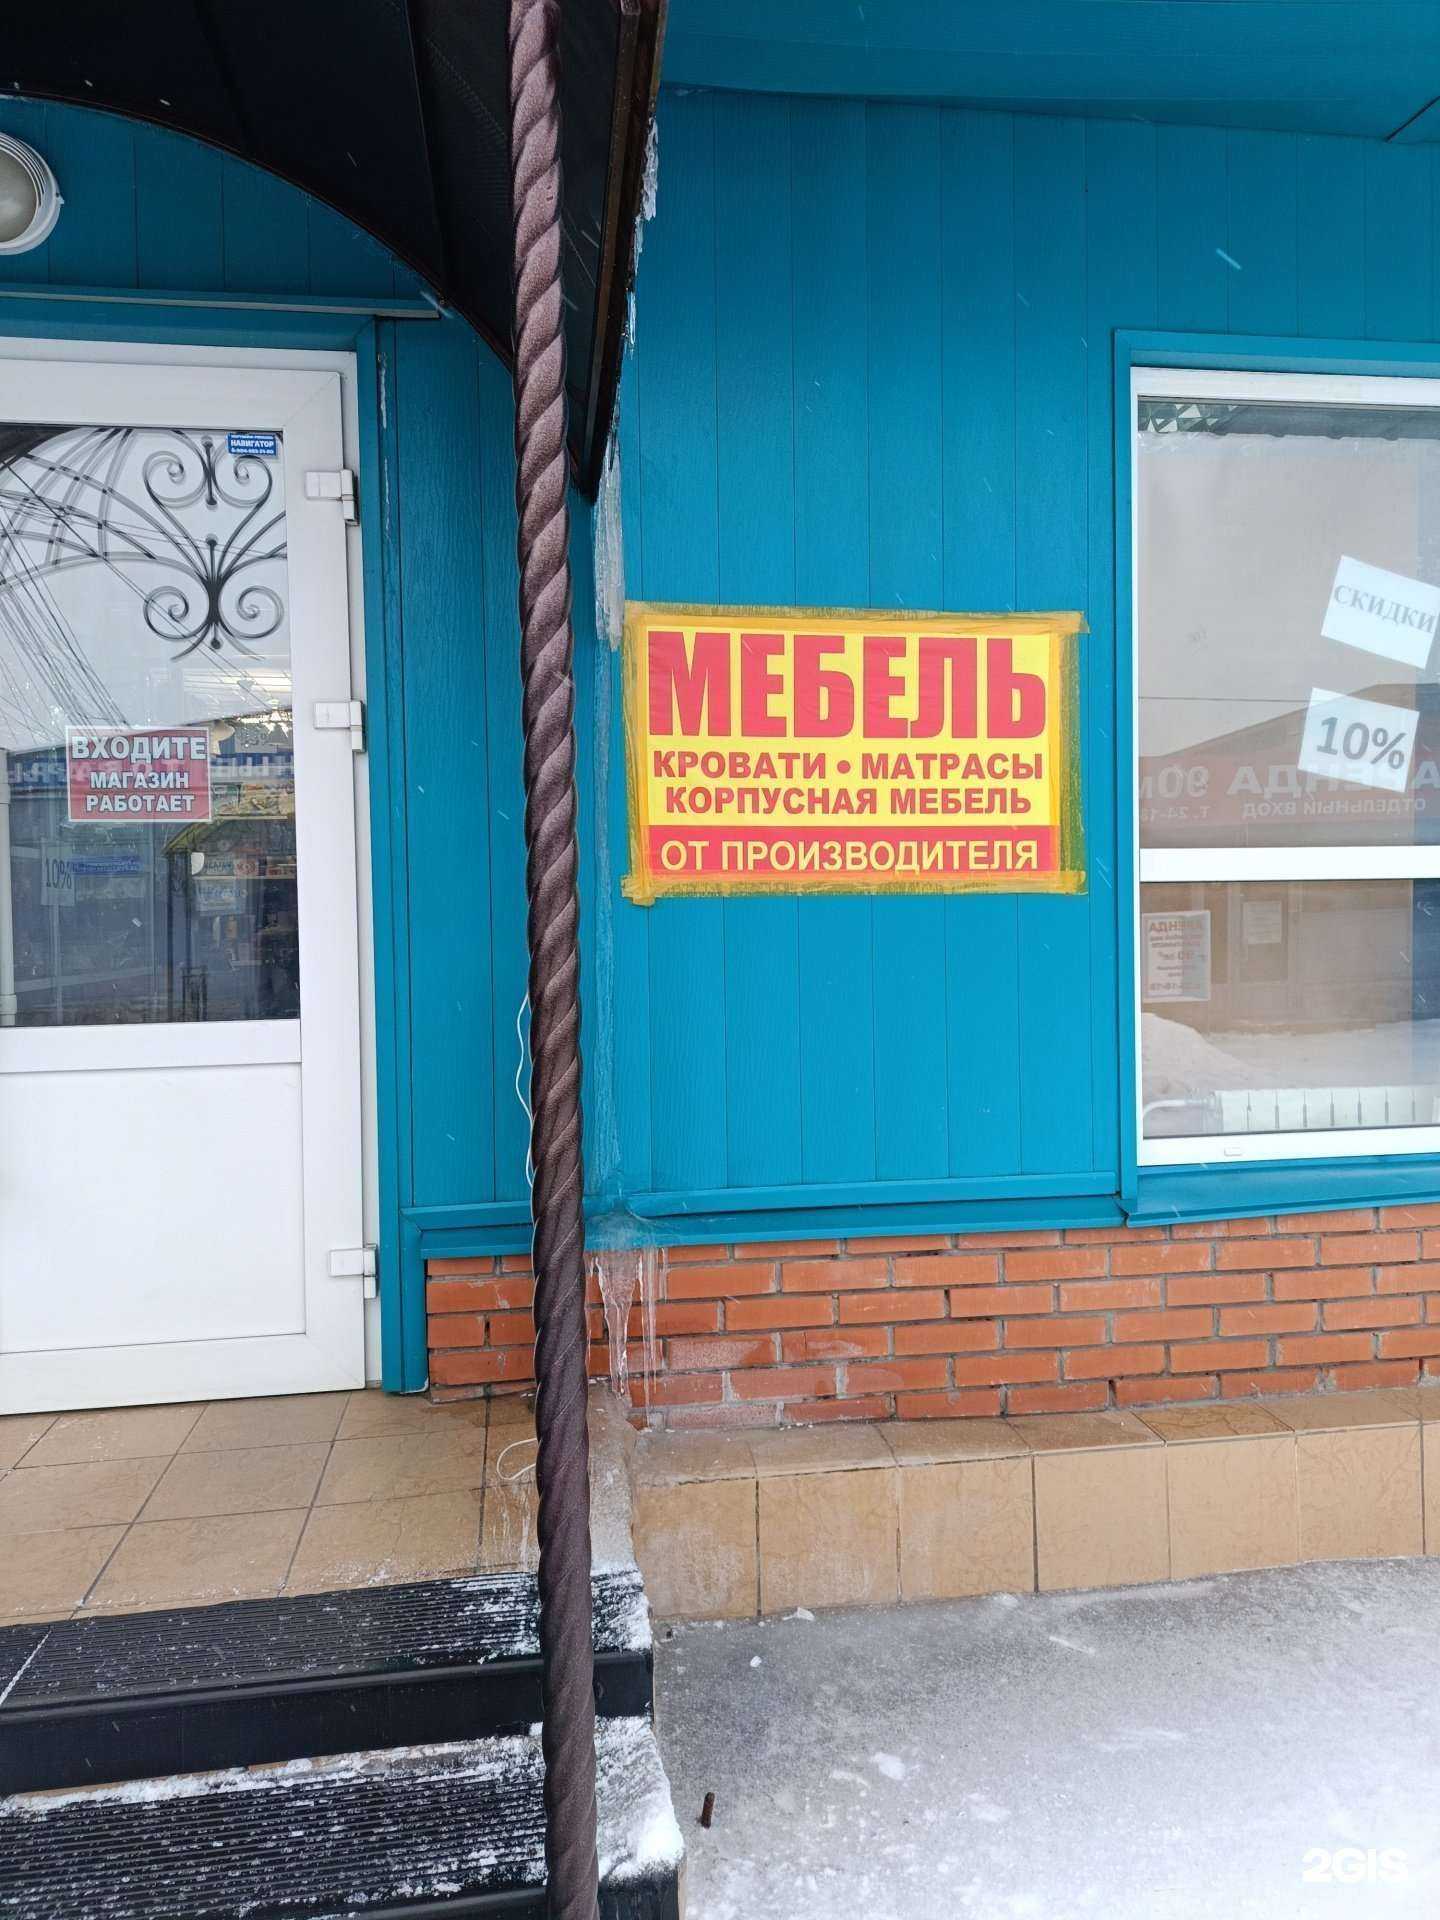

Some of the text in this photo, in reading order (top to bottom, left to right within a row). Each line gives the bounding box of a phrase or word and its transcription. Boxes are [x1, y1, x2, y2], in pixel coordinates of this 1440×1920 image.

[1333, 584, 1436, 634] СКИДКИ
[647, 630, 1046, 739] МЕБЕЛЬ
[71, 735, 207, 764] ВХОДИТЕ
[1315, 716, 1407, 770] 10%
[653, 751, 1043, 779] КРОВАТИ МАТРАСЫ
[90, 771, 189, 789] МАГАЗИН
[86, 794, 196, 812] РАБОТАЕТ
[665, 786, 1032, 814] КОРПУСНАЯ МЕБЕЛЬ
[660, 839, 1039, 876] ОТ ПРОИЗВОДИТЕЛЯ
